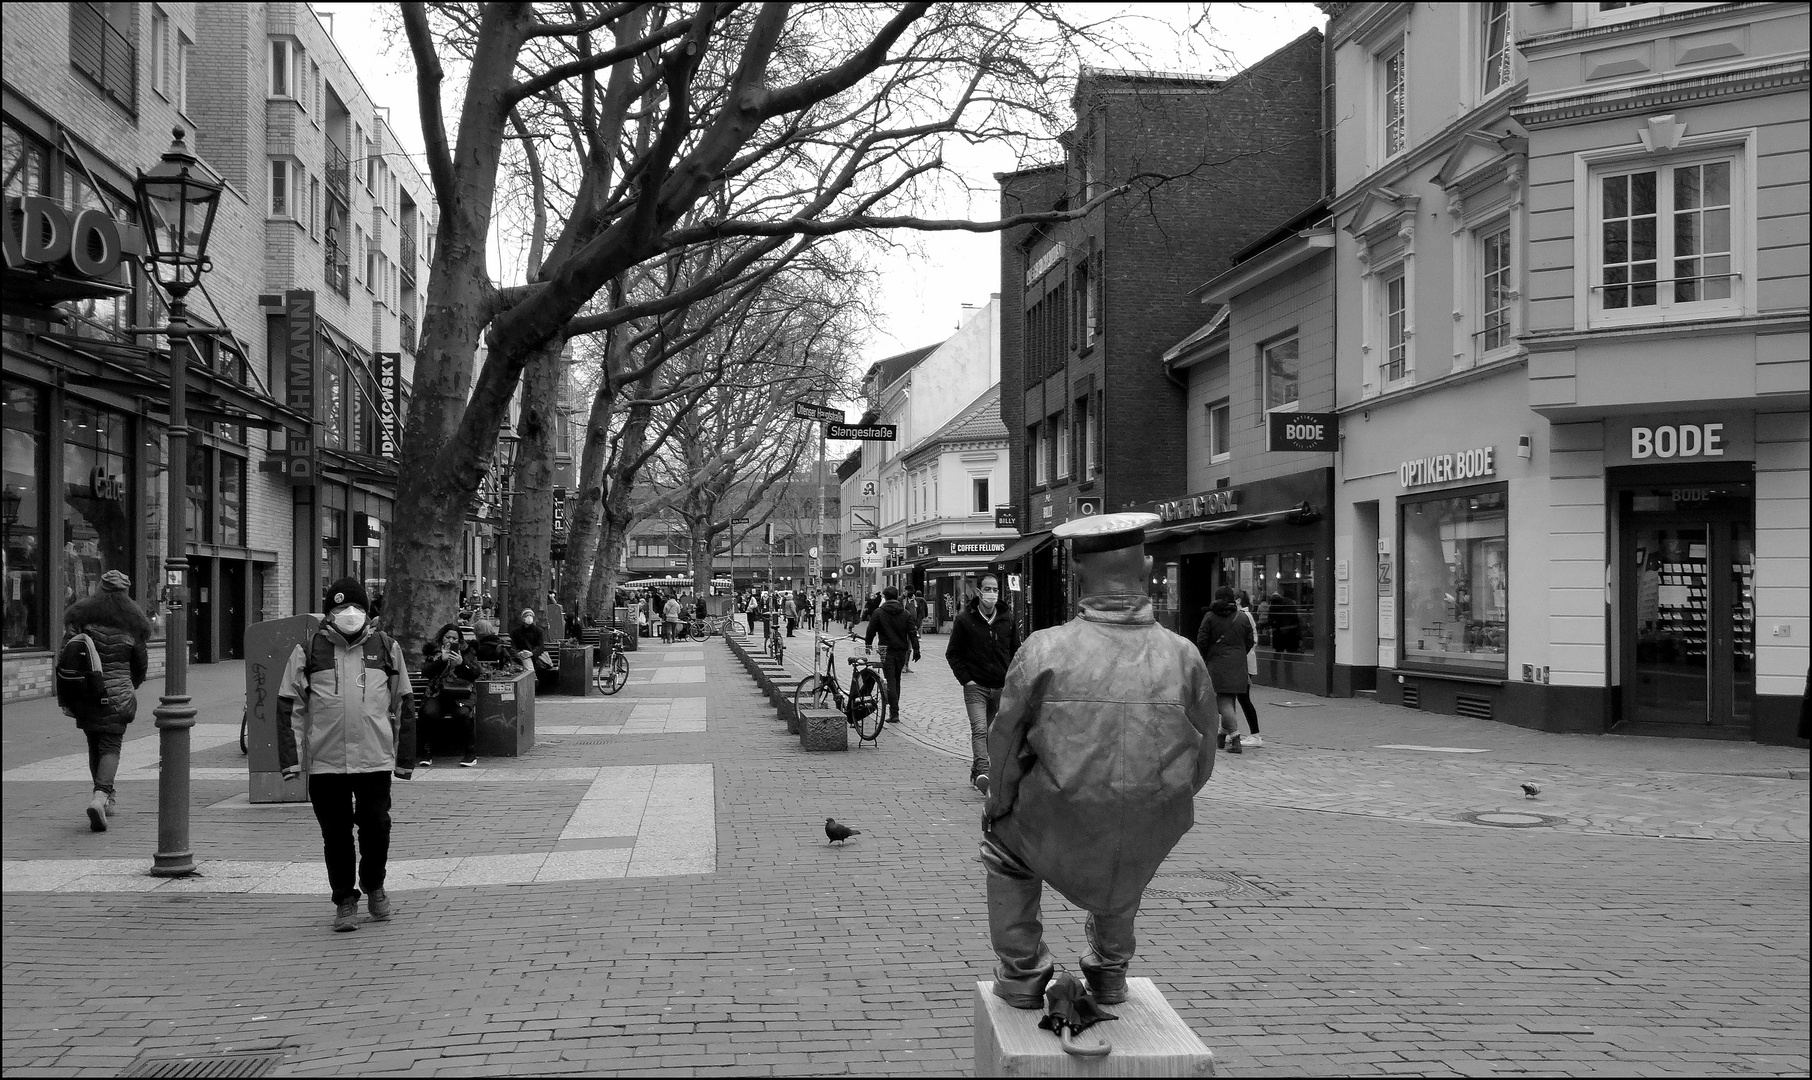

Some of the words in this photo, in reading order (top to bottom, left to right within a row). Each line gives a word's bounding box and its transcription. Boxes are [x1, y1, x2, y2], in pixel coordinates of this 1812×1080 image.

[290, 298, 310, 478] DEHMANN
[831, 425, 893, 439] Stangestraße
[1286, 424, 1324, 440] BODE
[1631, 423, 1724, 459] BODE
[1400, 454, 1453, 487] OPTIKER
[1456, 446, 1493, 479] BODE
[1671, 488, 1710, 501] BODE
[957, 543, 978, 552] COFFEE
[979, 543, 1005, 552] FELLOWS
